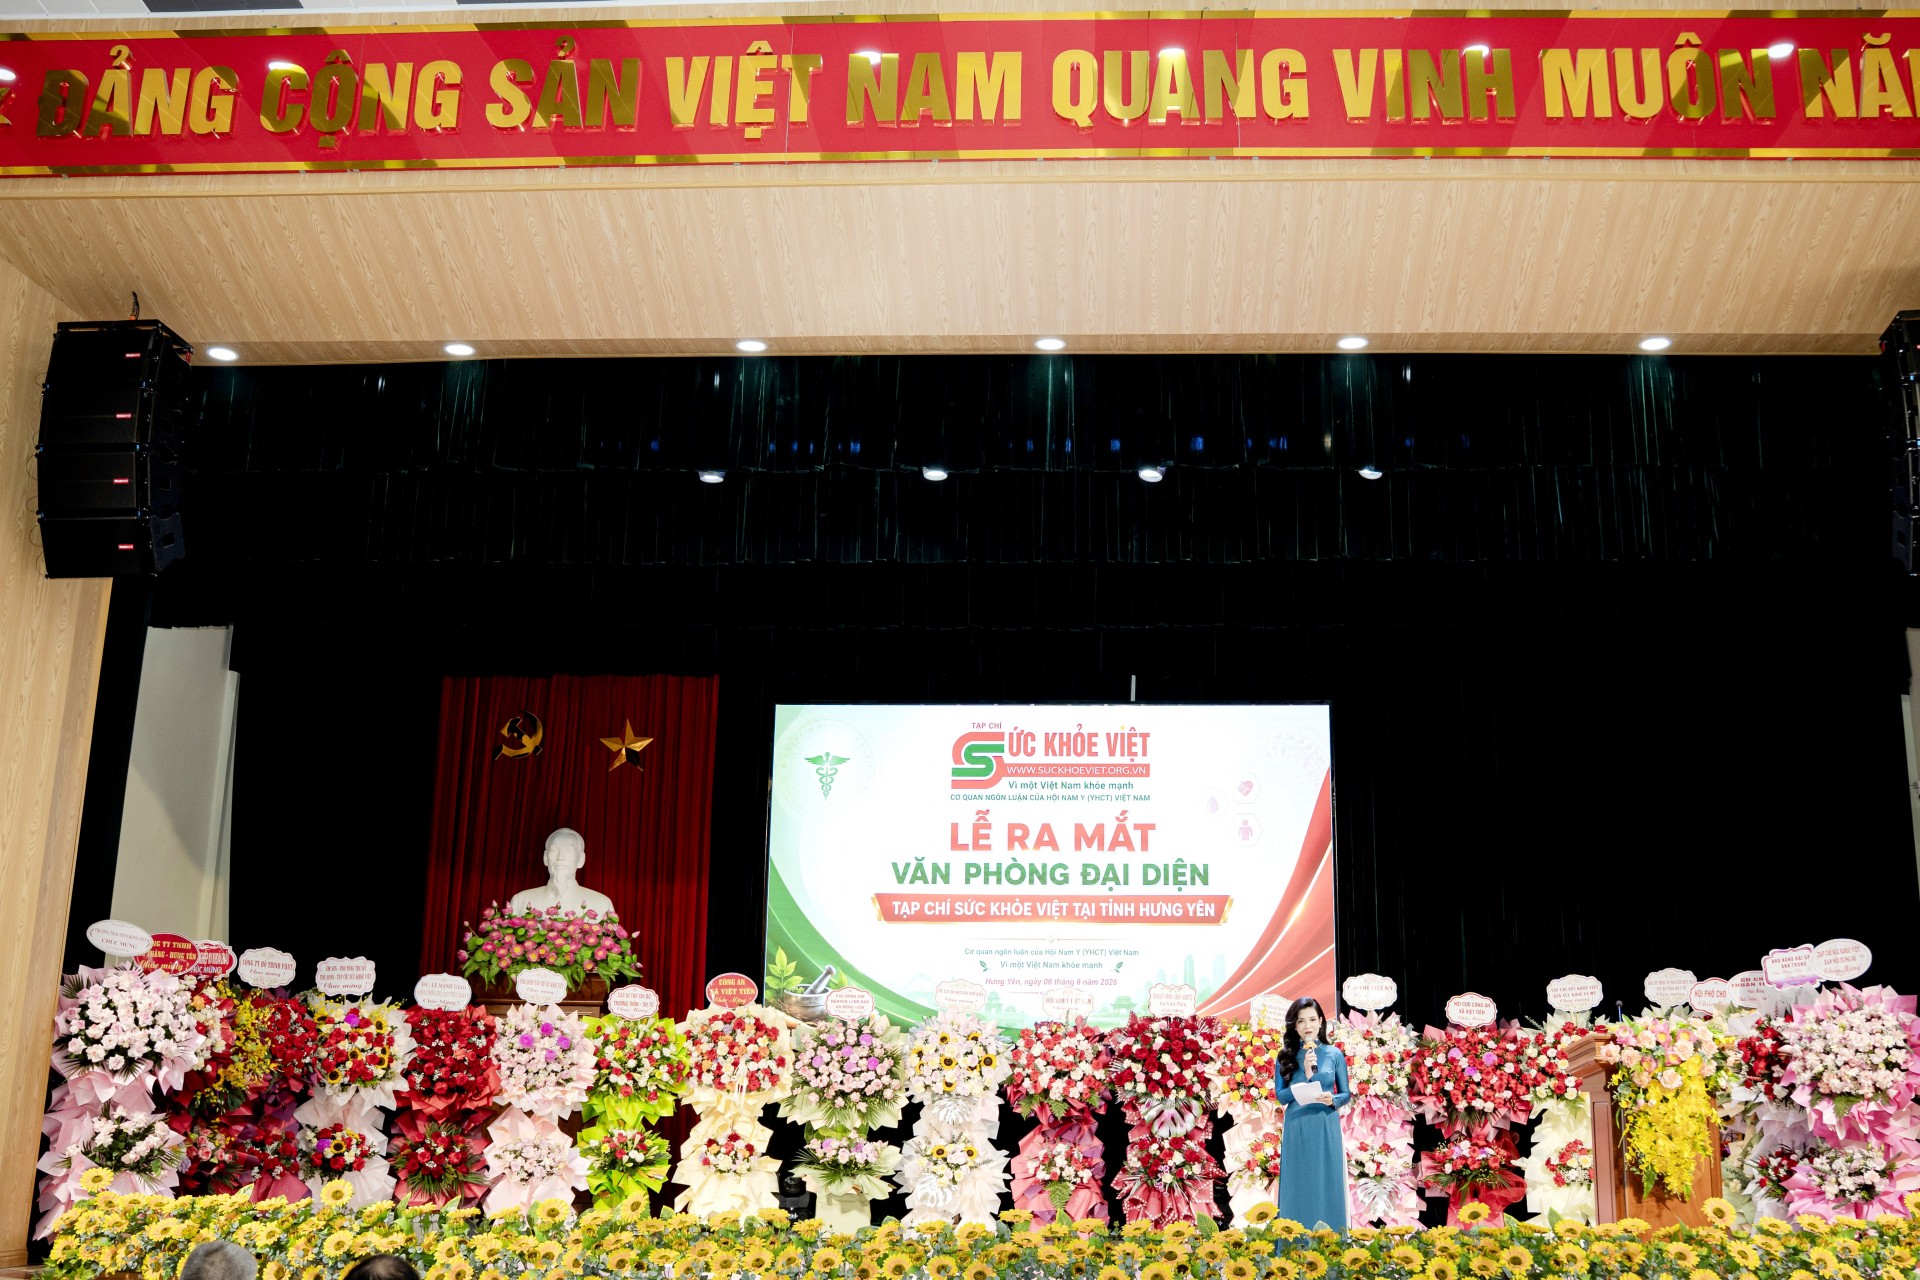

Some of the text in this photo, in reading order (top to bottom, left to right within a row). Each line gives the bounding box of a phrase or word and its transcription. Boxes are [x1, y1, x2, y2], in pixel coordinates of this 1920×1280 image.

[36, 32, 1920, 149] ĐẢNG CỘNG SẢN VIỆT NAM QUANG VINH MUÔN NĂ
[972, 721, 1002, 731] TẠP CHÍ
[1044, 723, 1098, 757] KHỎE
[1105, 726, 1150, 762] VIỆT
[1007, 766, 1146, 775] WWW.SUCKHOEVIET.ORG.VN
[1008, 781, 1018, 789] Vì
[1020, 781, 1037, 790] một
[1040, 780, 1058, 791] Việt
[1061, 781, 1081, 789] Nam
[1108, 781, 1134, 791] mạnh
[950, 793, 961, 801] CƠ
[962, 793, 983, 802] QUAN
[985, 792, 1006, 801] NGÔN
[1008, 792, 1028, 803] LUẬN
[1029, 792, 1045, 801] CỦA
[1046, 793, 1059, 803] HỘI
[1087, 794, 1113, 803] (YHCT)
[1114, 793, 1131, 803] VIỆT
[950, 809, 1156, 852] LỄ RA MẮT
[891, 856, 1209, 892] VĂN PHÒNG ĐẠI DIỆN
[892, 898, 1216, 920] TẠP CHÍ SỨC KHỎE VIỆT TẠI TỈNH HƯNG YÊN
[964, 947, 974, 955] Cơ
[975, 949, 993, 957] quan
[994, 948, 1012, 957] ngôn
[1058, 948, 1074, 956] Nam
[1075, 948, 1081, 956] Y
[1082, 948, 1107, 957] (YHCT)
[1108, 948, 1122, 957] Việt
[1009, 960, 1025, 970] một
[1026, 960, 1041, 970] Việt
[1081, 961, 1103, 970] mạnh
[737, 978, 746, 986] AN
[985, 977, 1005, 986] Hưng
[1024, 977, 1042, 987] ngày
[1043, 978, 1052, 986] 06
[1054, 978, 1075, 987] tháng
[1076, 978, 1081, 986] 6
[1082, 978, 1099, 986] năm
[1100, 978, 1118, 986] 2026
[720, 987, 738, 996] VIỆT
